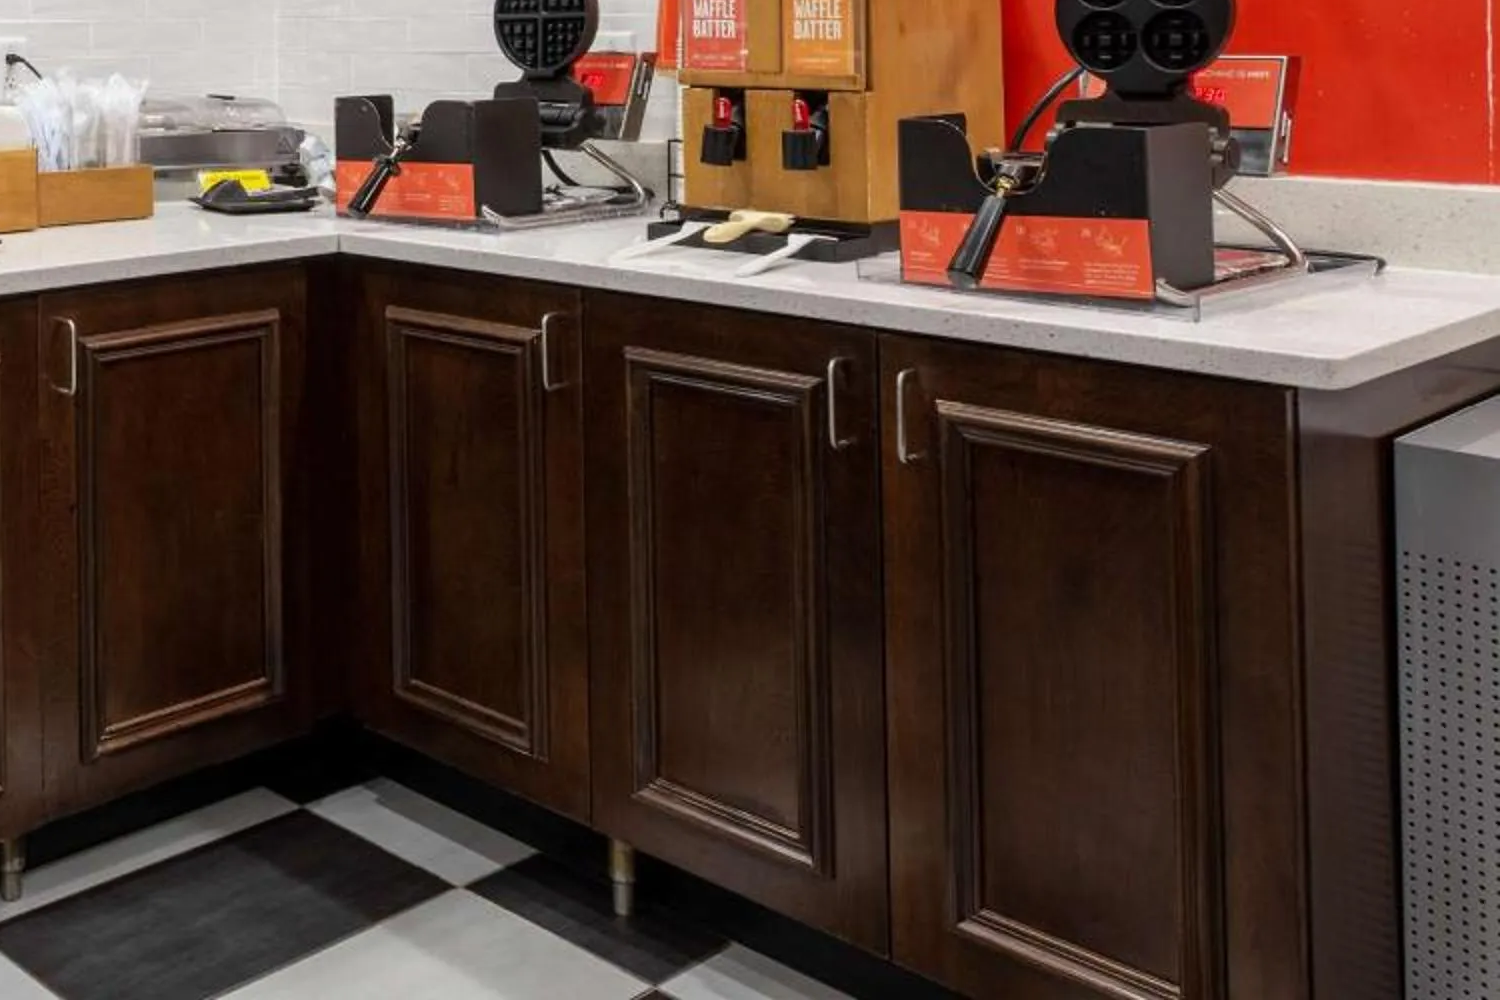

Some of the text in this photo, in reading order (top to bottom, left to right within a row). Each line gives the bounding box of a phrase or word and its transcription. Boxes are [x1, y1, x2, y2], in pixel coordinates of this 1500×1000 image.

[692, 0, 736, 19] WAFFLE
[692, 19, 736, 39] BATTER
[793, 19, 842, 41] BATTER
